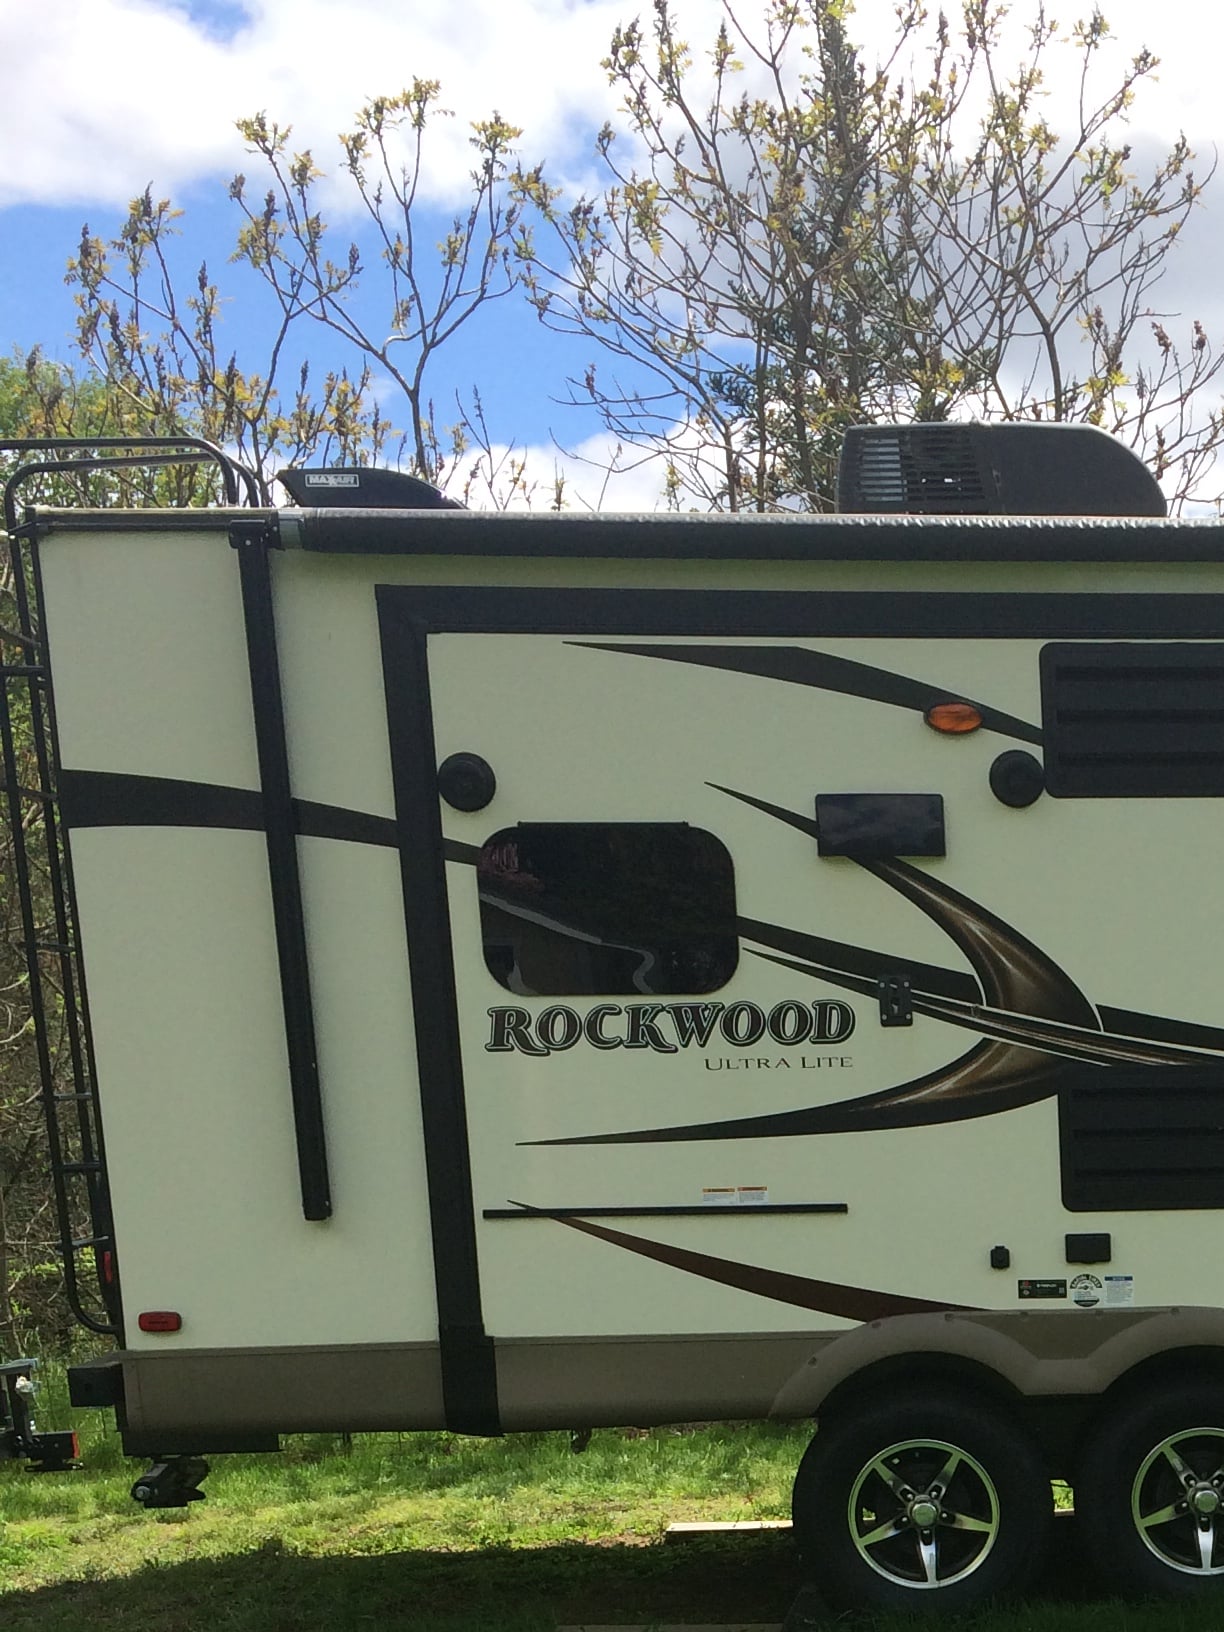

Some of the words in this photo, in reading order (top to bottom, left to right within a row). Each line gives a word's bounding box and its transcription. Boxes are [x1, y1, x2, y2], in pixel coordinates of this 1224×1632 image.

[485, 999, 856, 1056] ROCKWOOD
[704, 1057, 791, 1071] ULTRA
[801, 1056, 853, 1070] LITE
